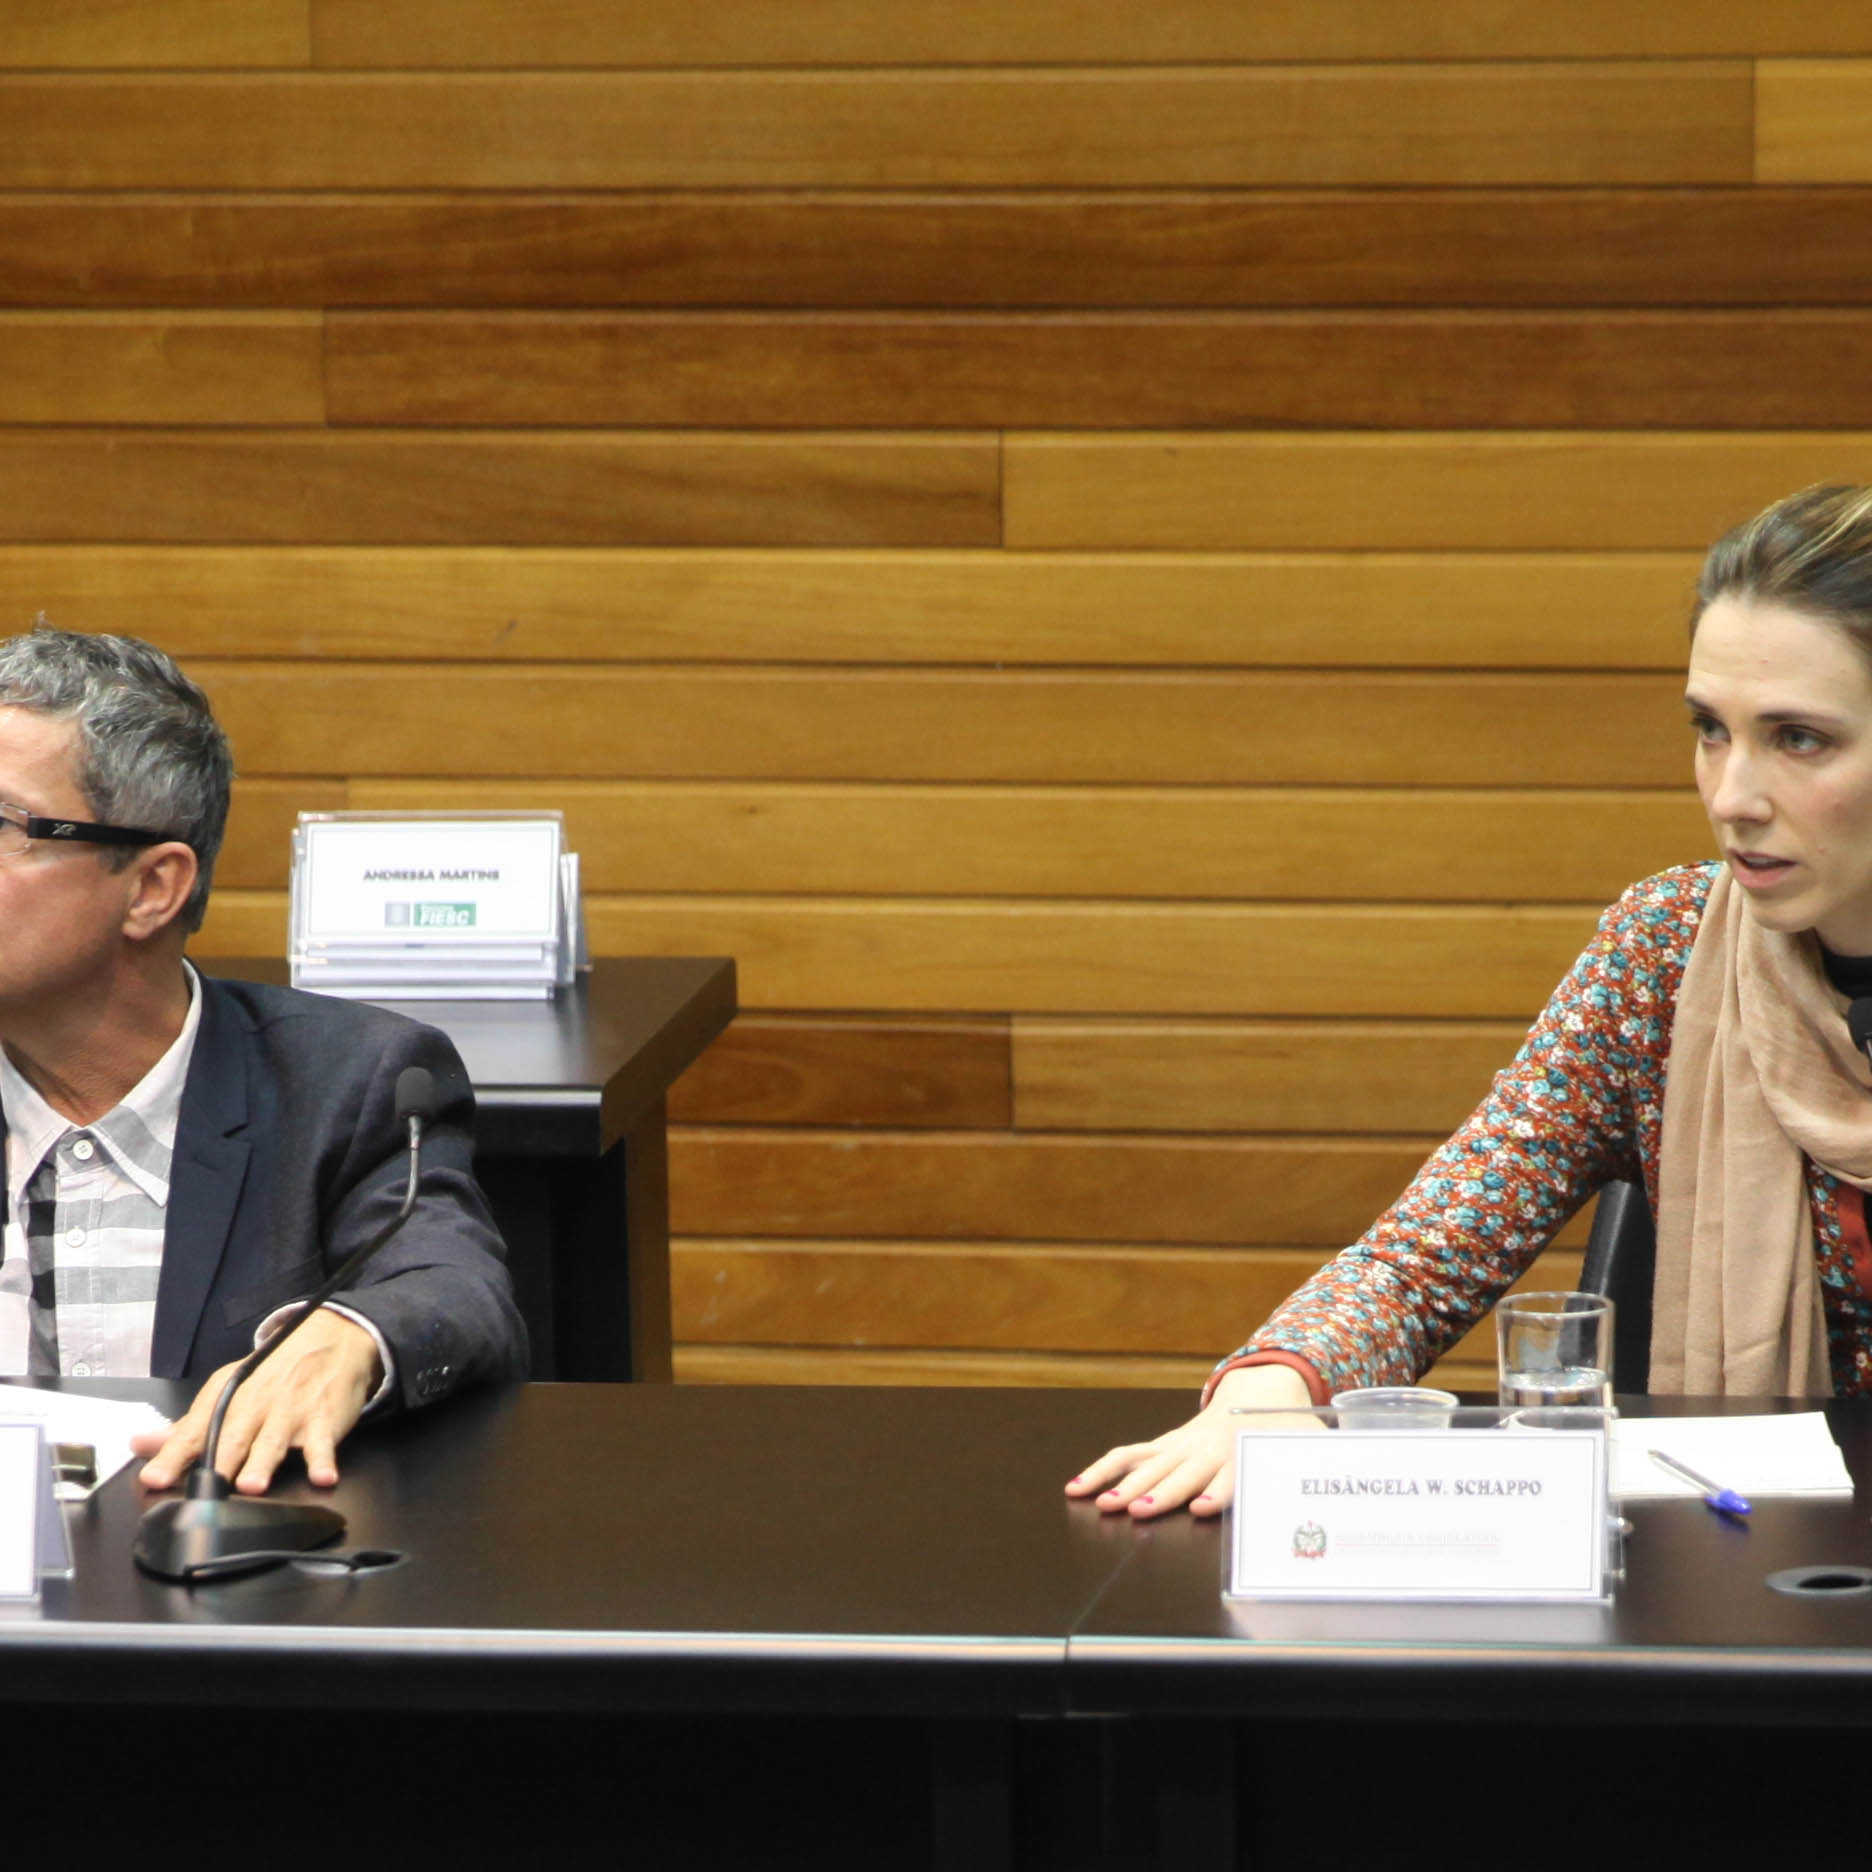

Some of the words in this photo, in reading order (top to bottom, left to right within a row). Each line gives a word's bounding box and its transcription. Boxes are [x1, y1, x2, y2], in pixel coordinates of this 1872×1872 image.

[439, 869, 499, 881] MARTINS
[1300, 1475, 1420, 1497] ELISÂNGELA
[1426, 1479, 1448, 1497] W.
[1454, 1479, 1543, 1497] SCHAPPO
